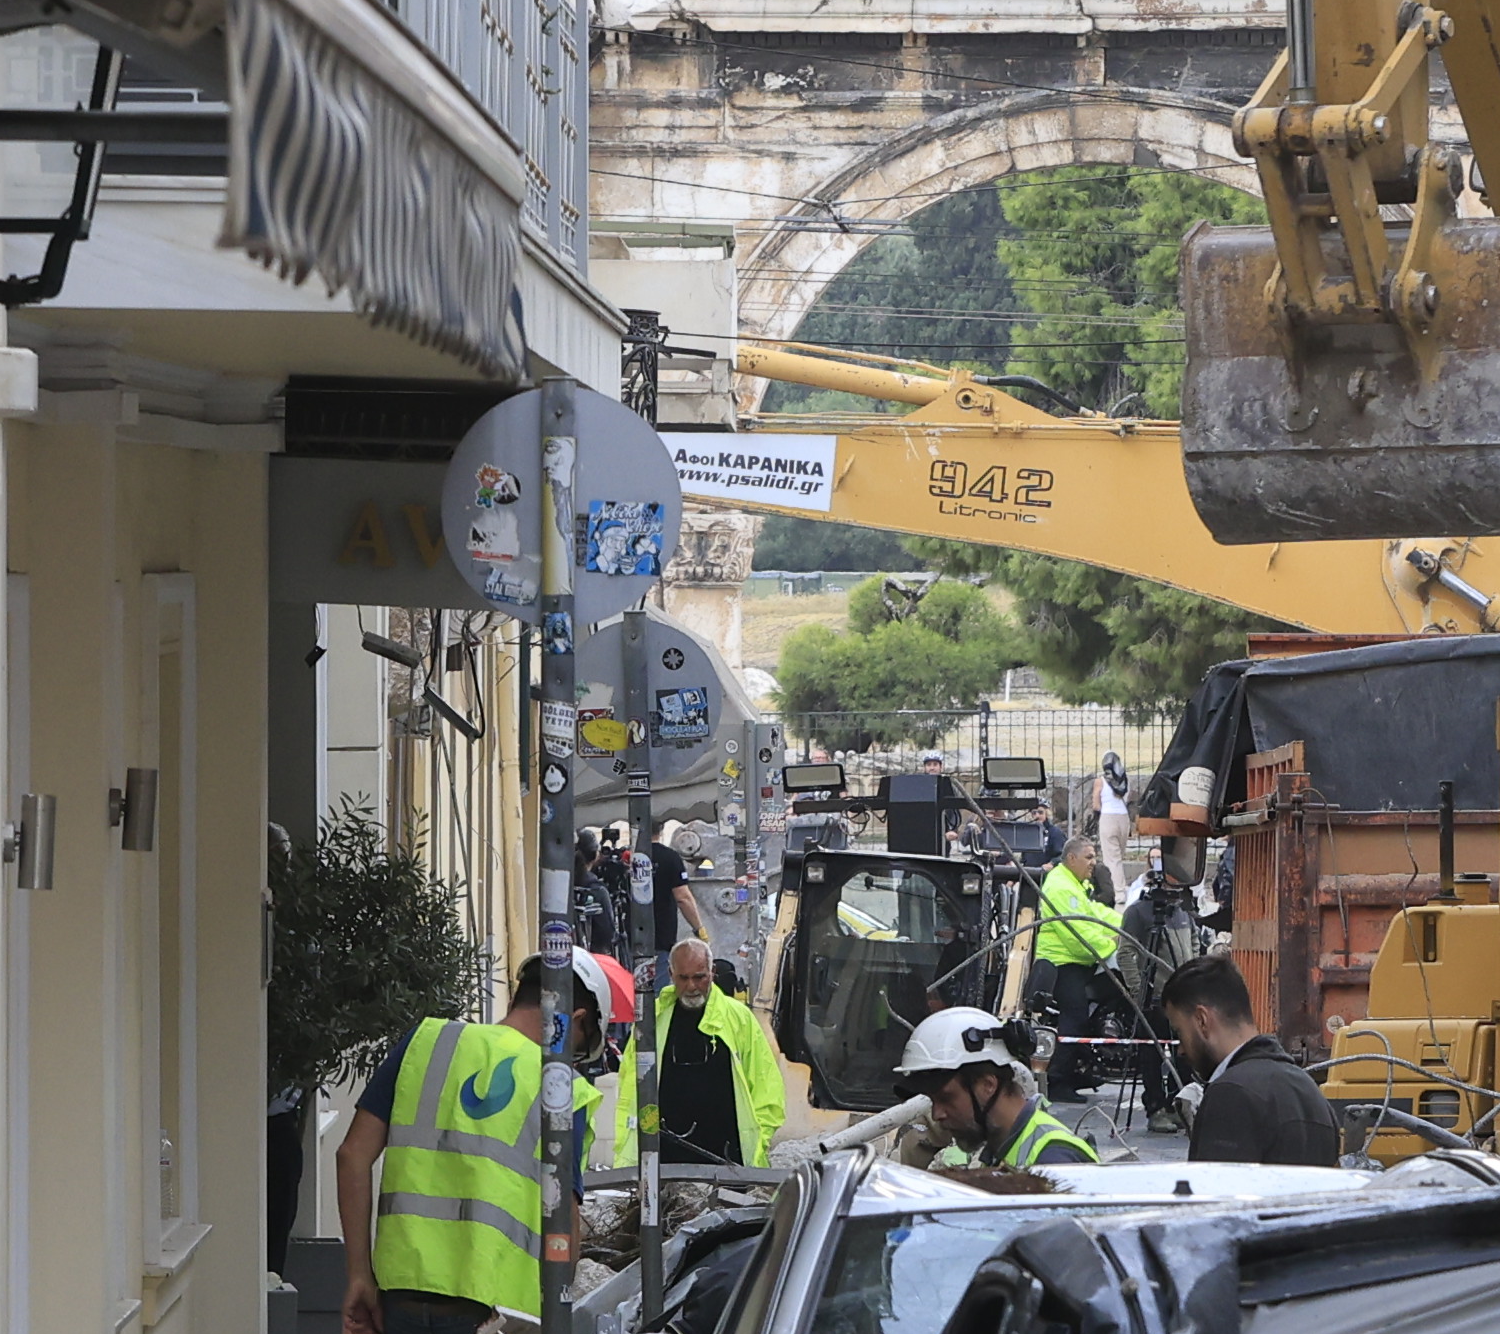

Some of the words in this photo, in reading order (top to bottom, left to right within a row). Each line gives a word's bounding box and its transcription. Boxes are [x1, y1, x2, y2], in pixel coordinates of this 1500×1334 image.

[717, 451, 825, 478] ΚΑΡΑΝΙΚΑ
[675, 467, 825, 496] www.psalidi.gr
[928, 459, 1054, 509] 942
[938, 500, 1037, 524] Litronic
